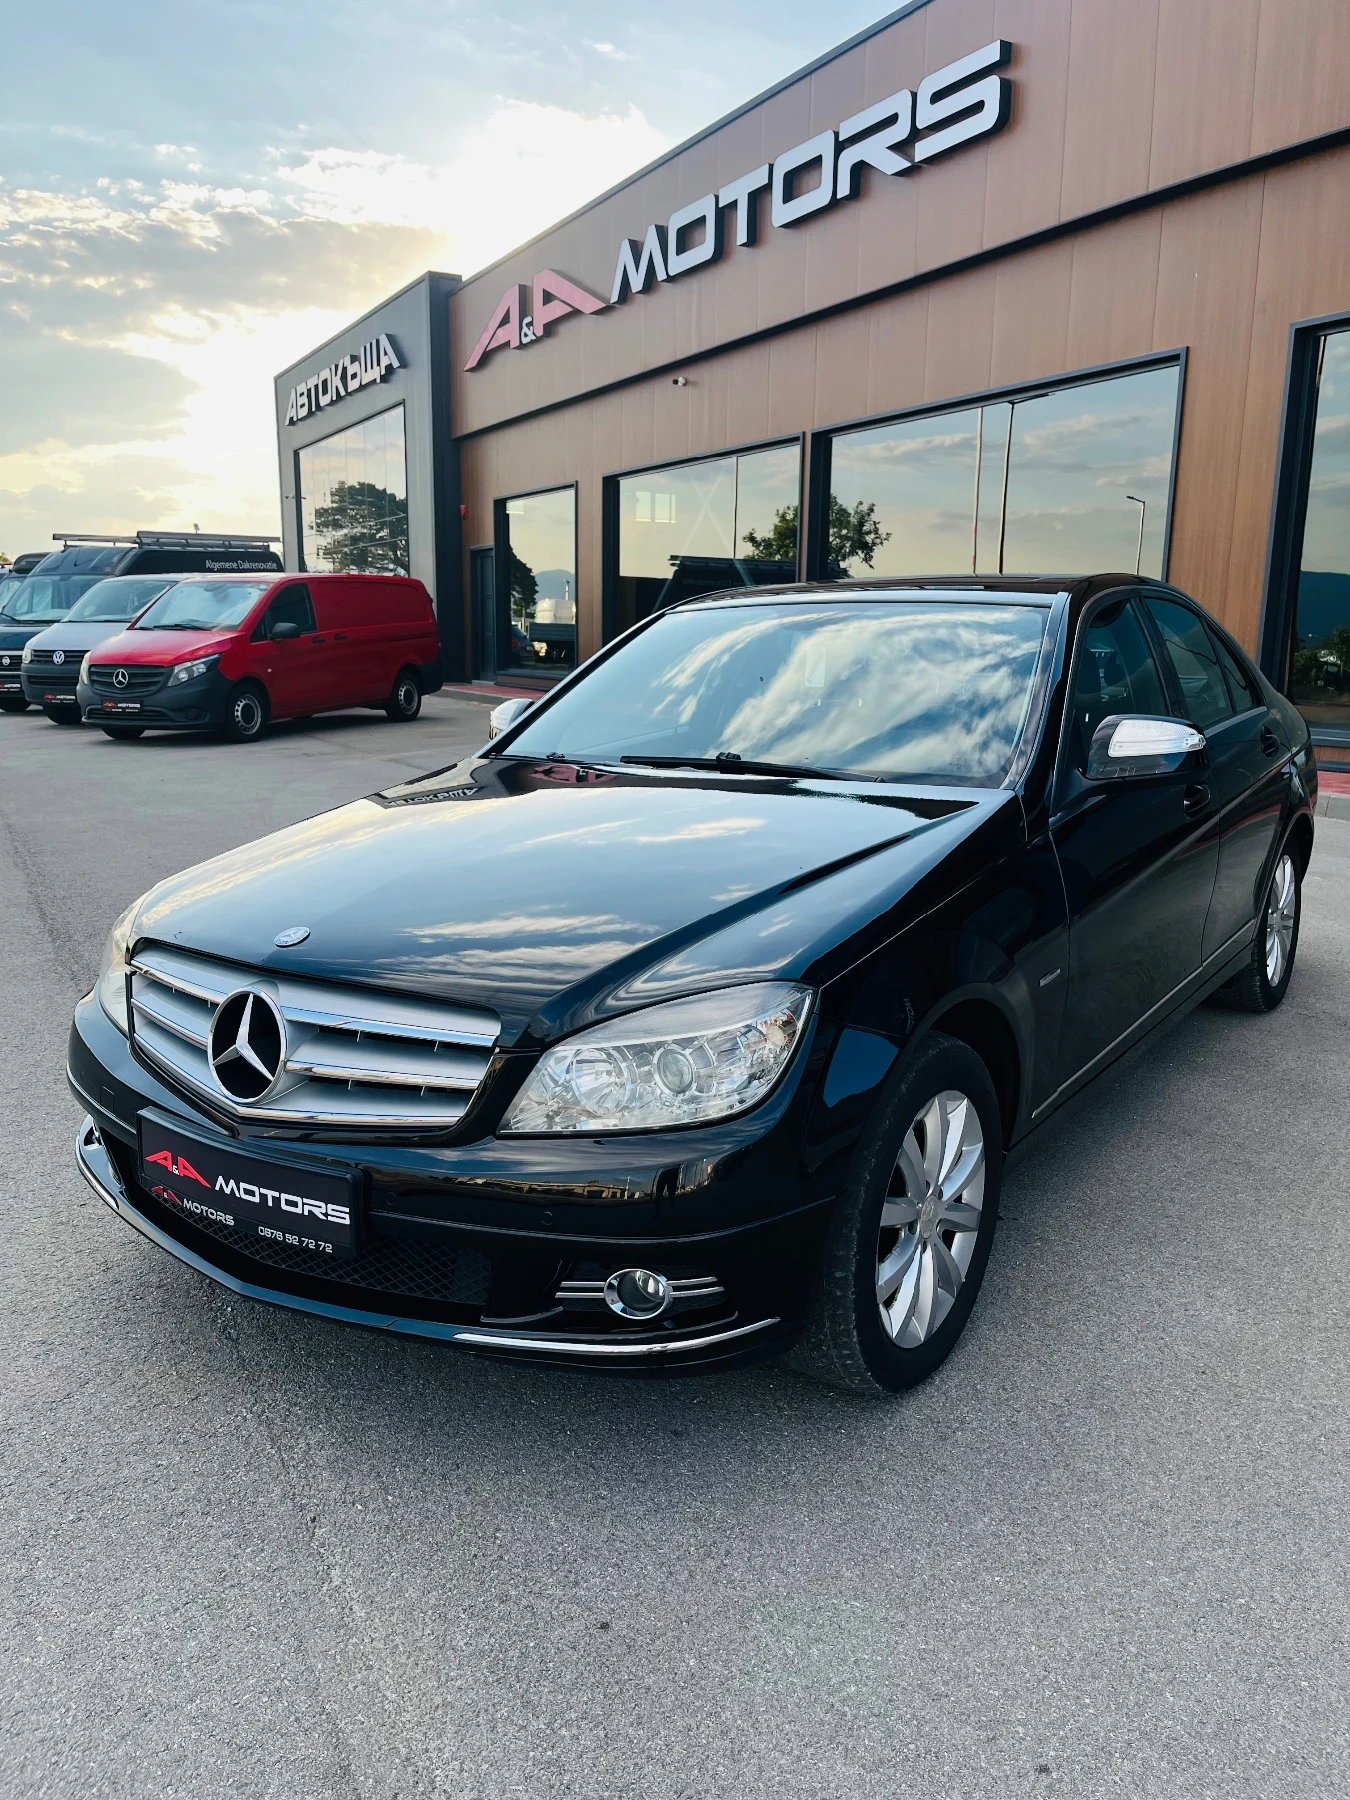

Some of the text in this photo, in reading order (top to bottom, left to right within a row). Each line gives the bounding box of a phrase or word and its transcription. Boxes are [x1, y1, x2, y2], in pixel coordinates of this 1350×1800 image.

[463, 38, 1011, 372] A&A MOTORS
[285, 333, 400, 426] АВТОКЪЩА
[205, 560, 278, 571] Algemene Dakrenovatie
[145, 1150, 350, 1225] A&A MOTORS
[183, 1198, 235, 1226] MOTORS
[285, 1234, 300, 1245] 52
[301, 1237, 316, 1249] 72
[318, 1241, 333, 1253] 72
